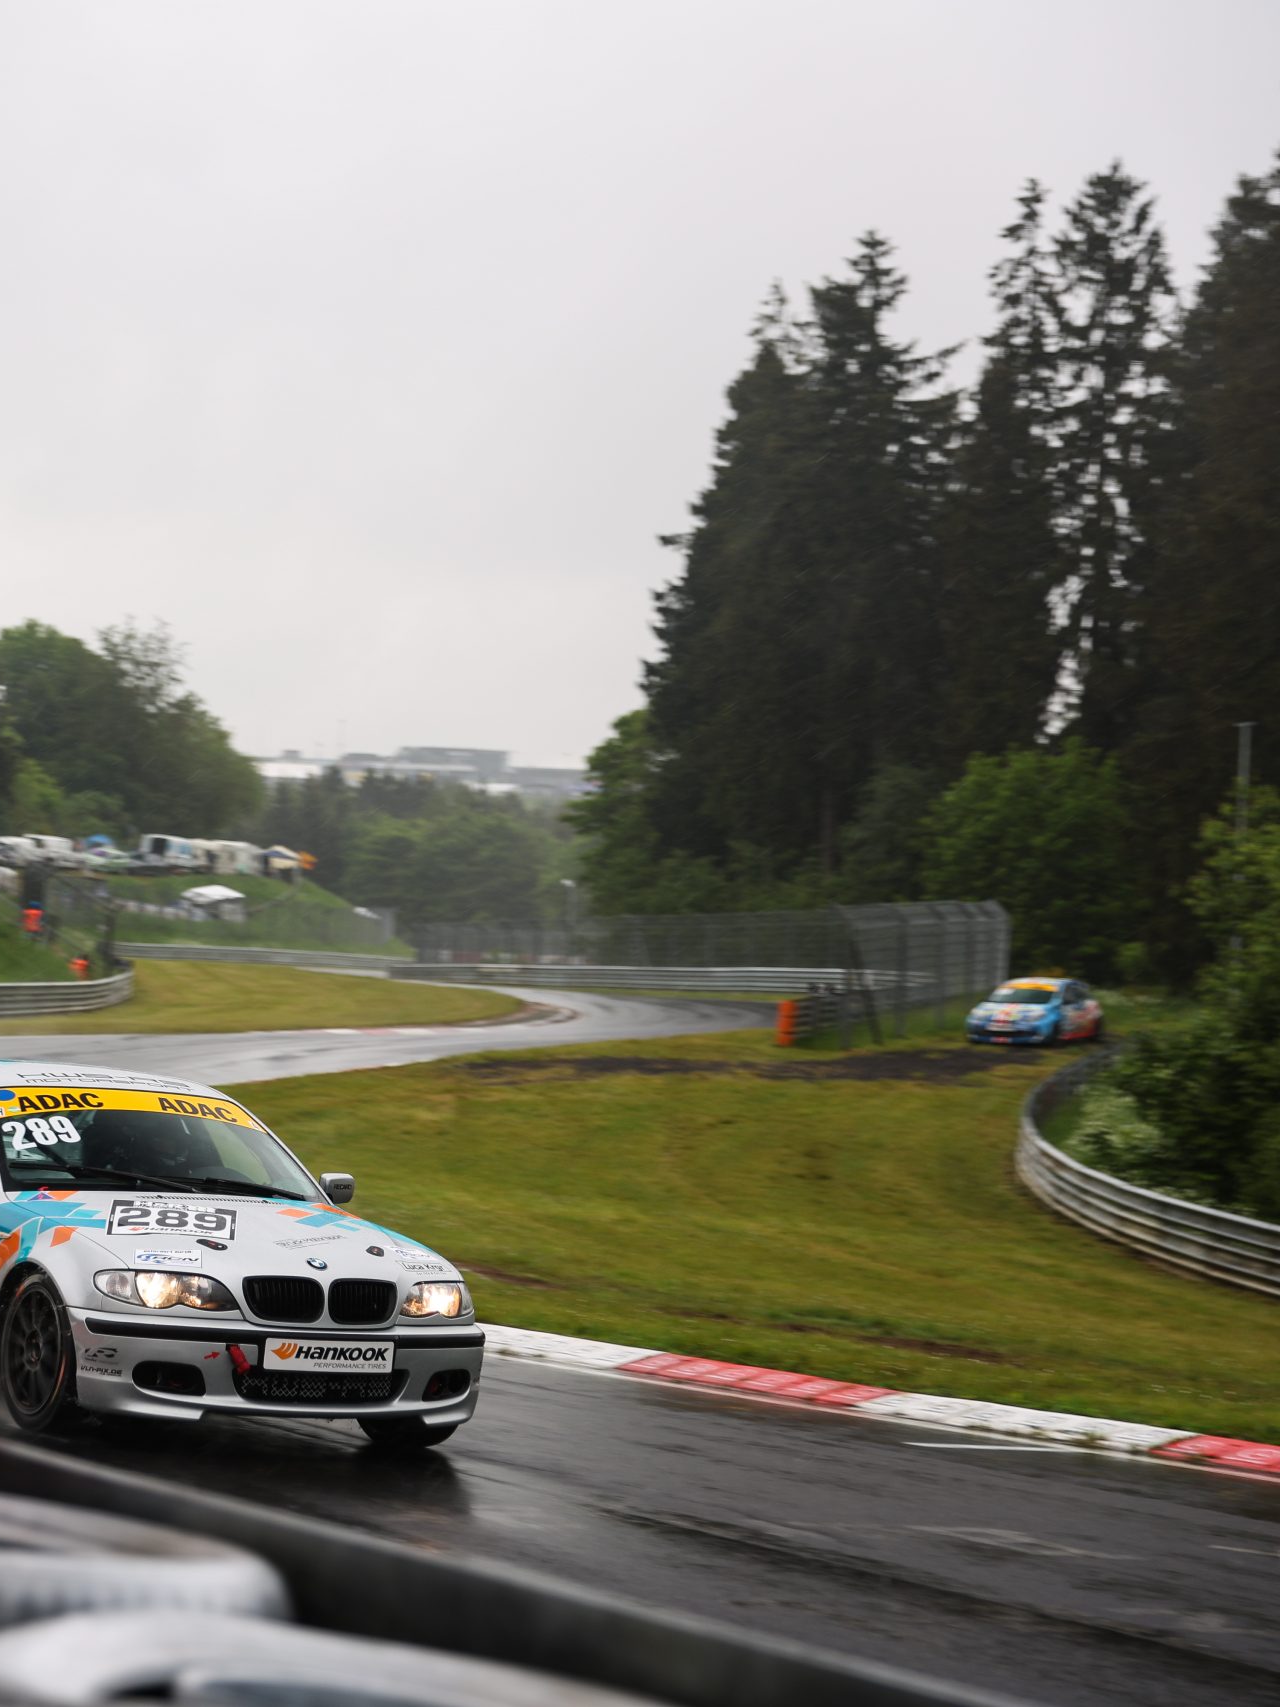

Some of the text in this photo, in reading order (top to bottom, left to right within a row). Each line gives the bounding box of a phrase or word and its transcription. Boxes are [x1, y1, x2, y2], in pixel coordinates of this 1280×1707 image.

[18, 1093, 238, 1122] ADAC ADAC
[1, 1115, 81, 1151] 289
[117, 1207, 227, 1231] 289
